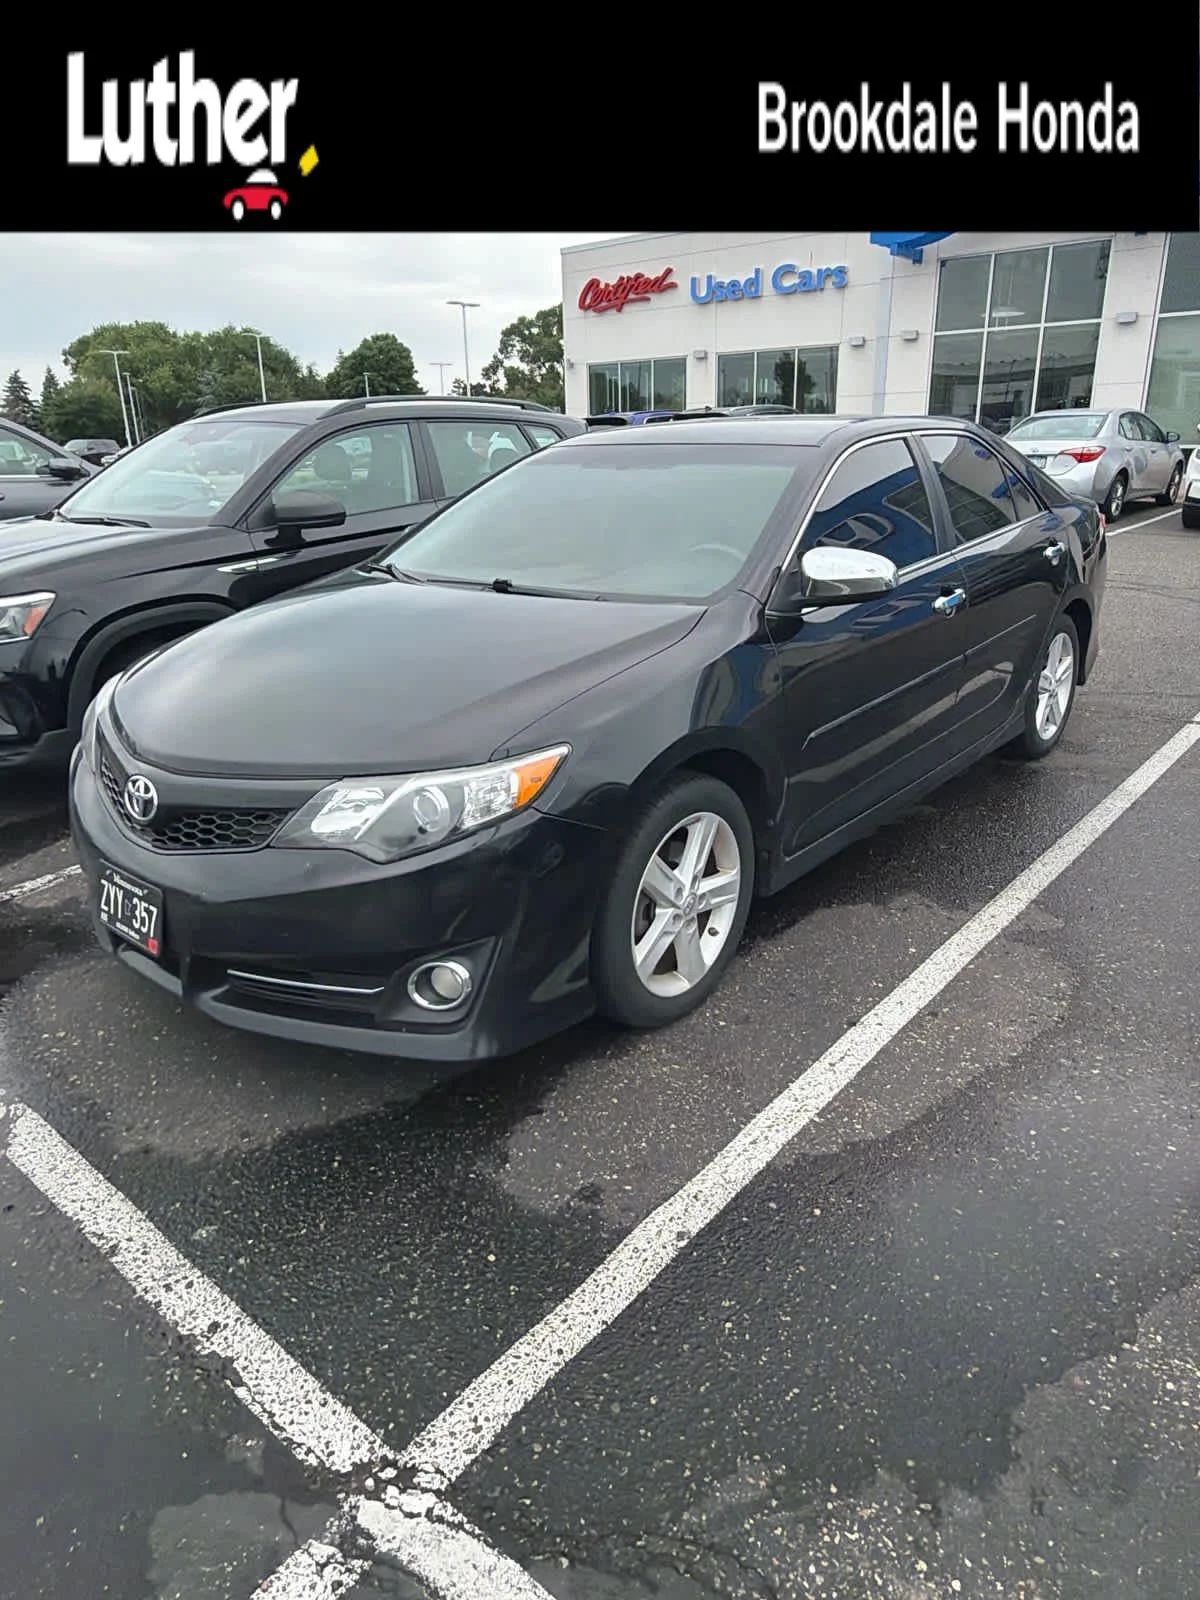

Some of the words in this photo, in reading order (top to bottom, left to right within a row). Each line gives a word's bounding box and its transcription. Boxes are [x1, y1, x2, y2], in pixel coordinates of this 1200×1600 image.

[578, 268, 678, 312] Certified
[690, 268, 761, 304] Used
[770, 263, 847, 294] Cars
[100, 879, 123, 919] ZYY
[132, 897, 157, 938] 357
